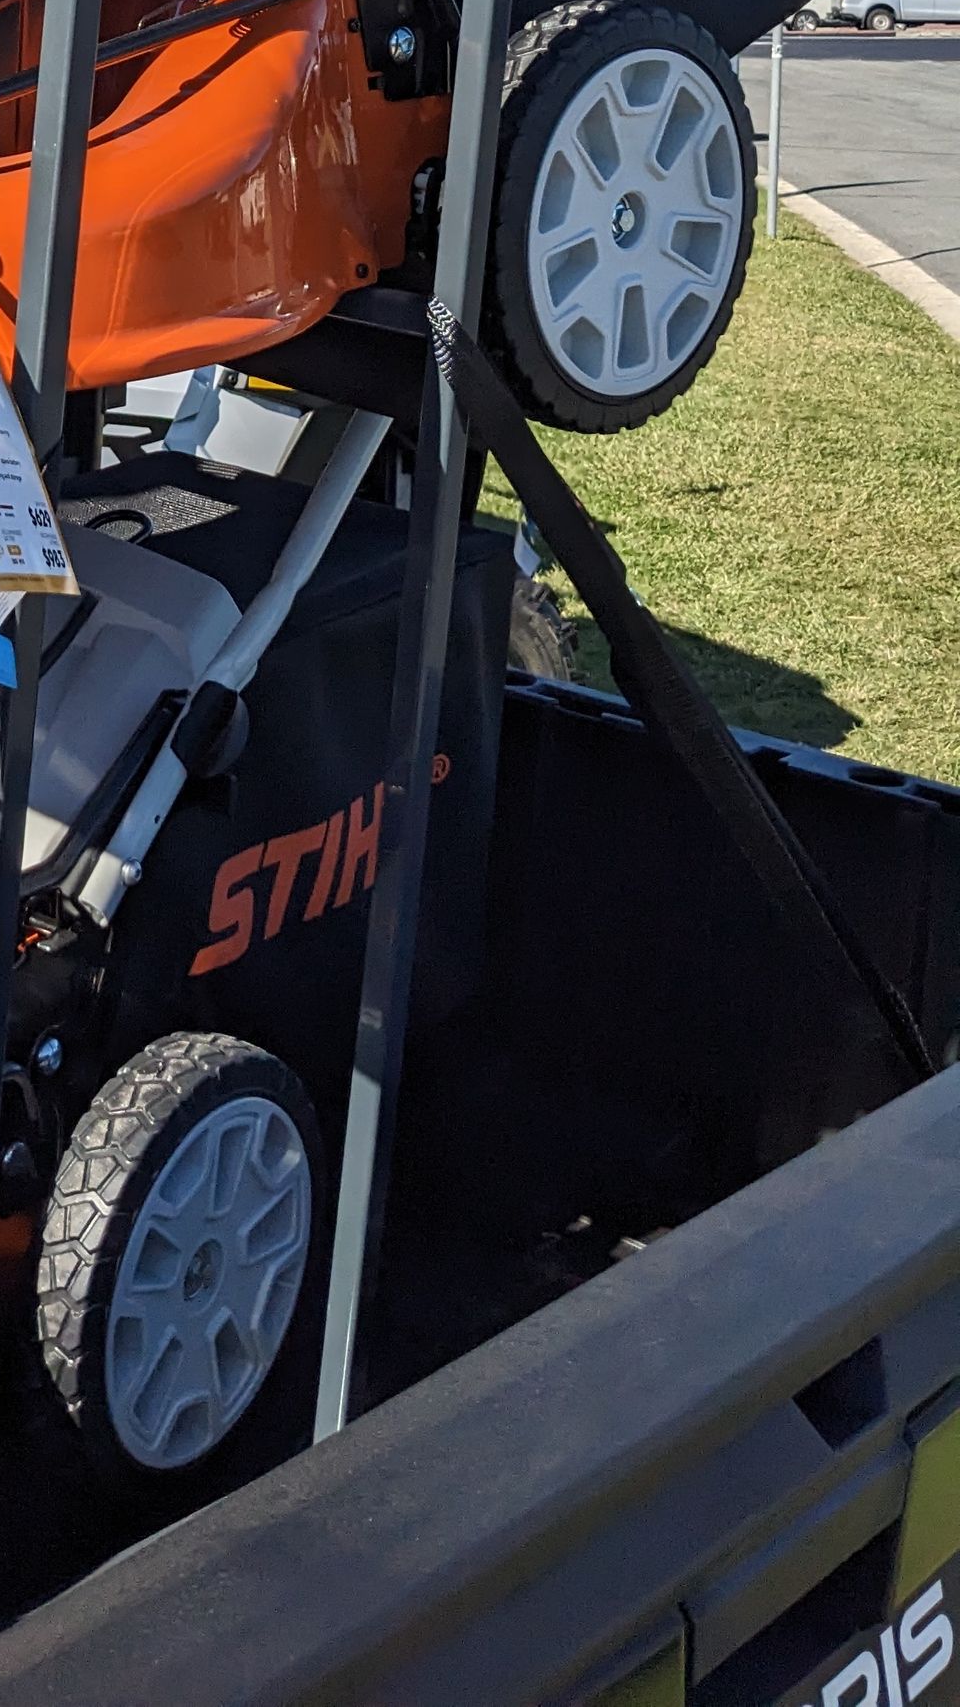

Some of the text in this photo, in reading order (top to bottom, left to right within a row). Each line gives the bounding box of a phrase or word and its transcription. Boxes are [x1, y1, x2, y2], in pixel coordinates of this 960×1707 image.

[28, 505, 52, 528] $629
[42, 546, 66, 570] $983
[188, 780, 385, 976] STIH
